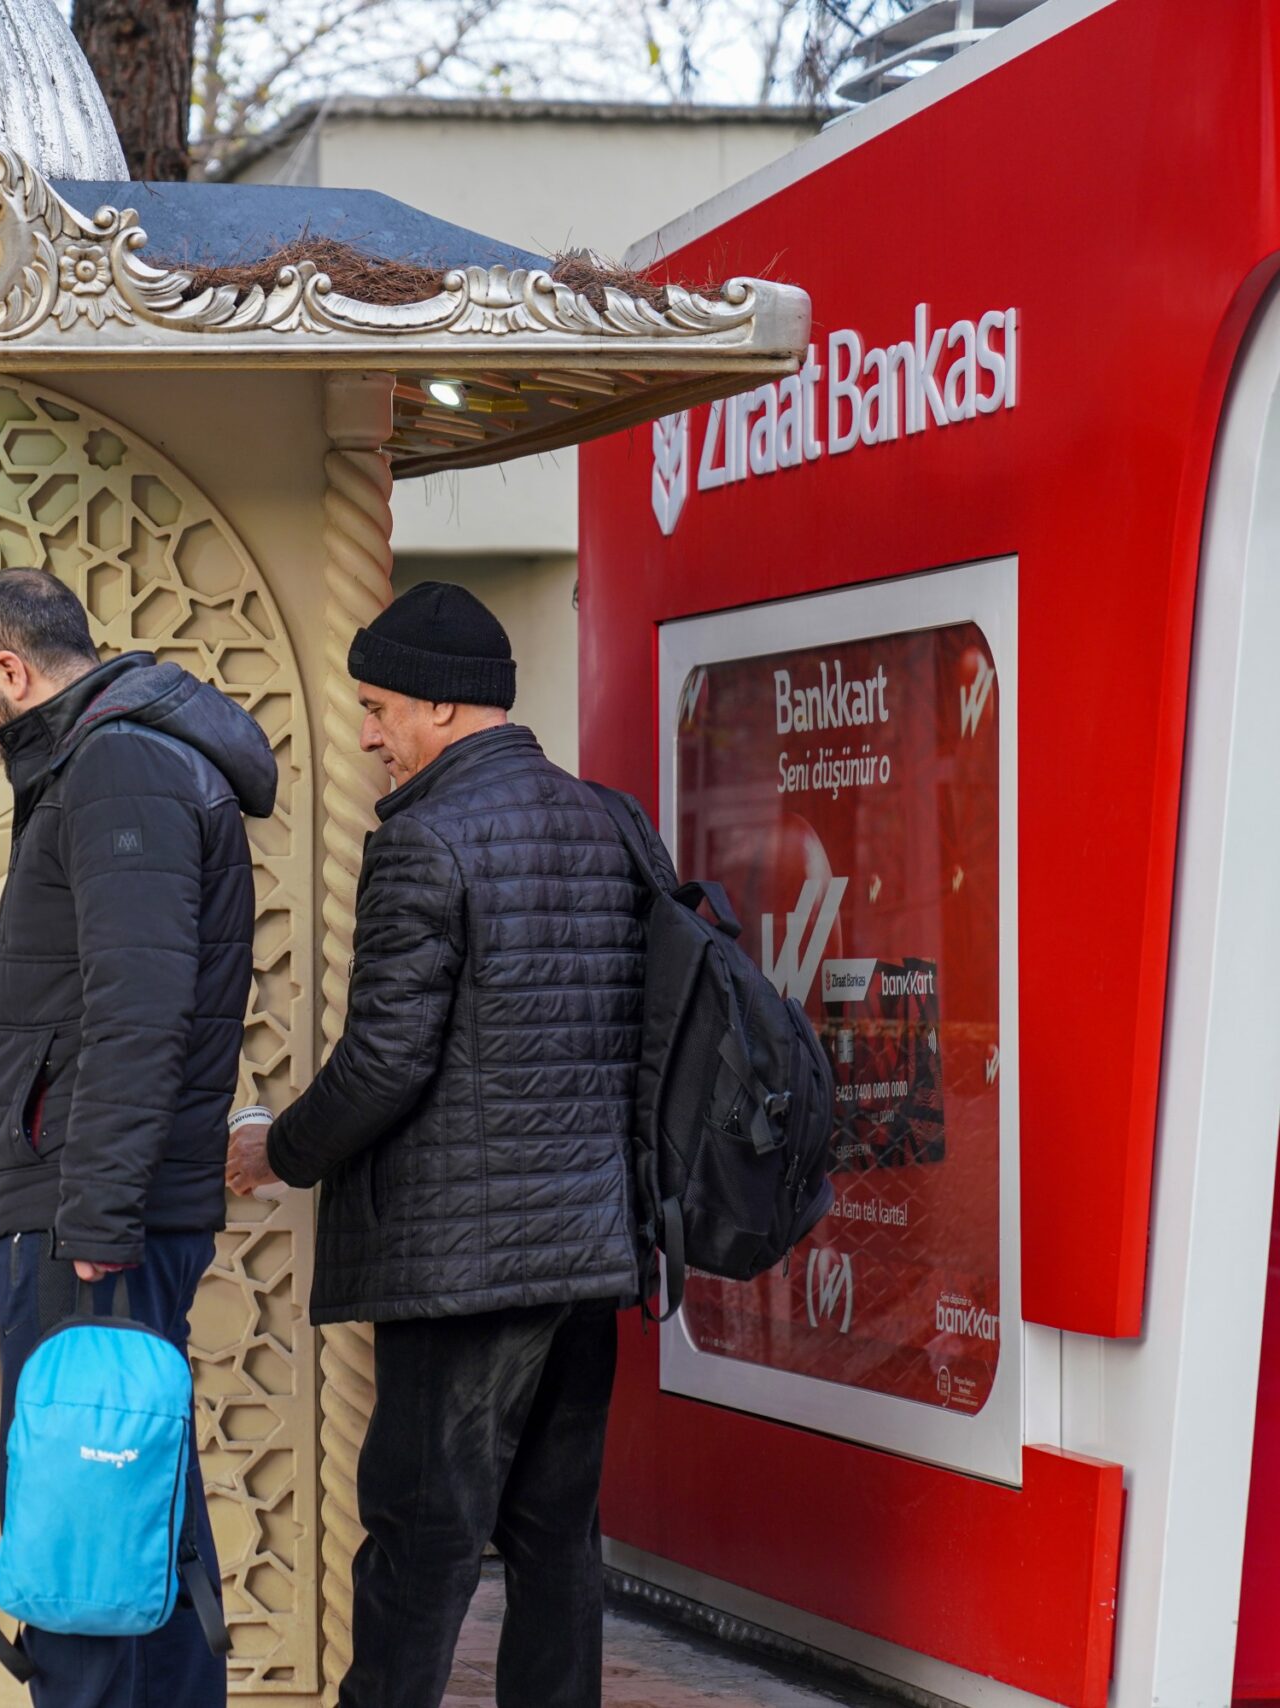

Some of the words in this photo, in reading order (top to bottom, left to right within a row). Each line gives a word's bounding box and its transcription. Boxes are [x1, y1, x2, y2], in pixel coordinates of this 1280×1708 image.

[697, 343, 821, 491] Ziraat
[828, 303, 1018, 455] Bankası
[774, 659, 889, 735] Bankkart
[777, 750, 809, 793] Seni
[812, 744, 878, 800] düşünür
[879, 755, 891, 784] o
[881, 969, 935, 996] bankkart
[863, 1198, 877, 1222] tek
[936, 1300, 1000, 1340] bankkar
